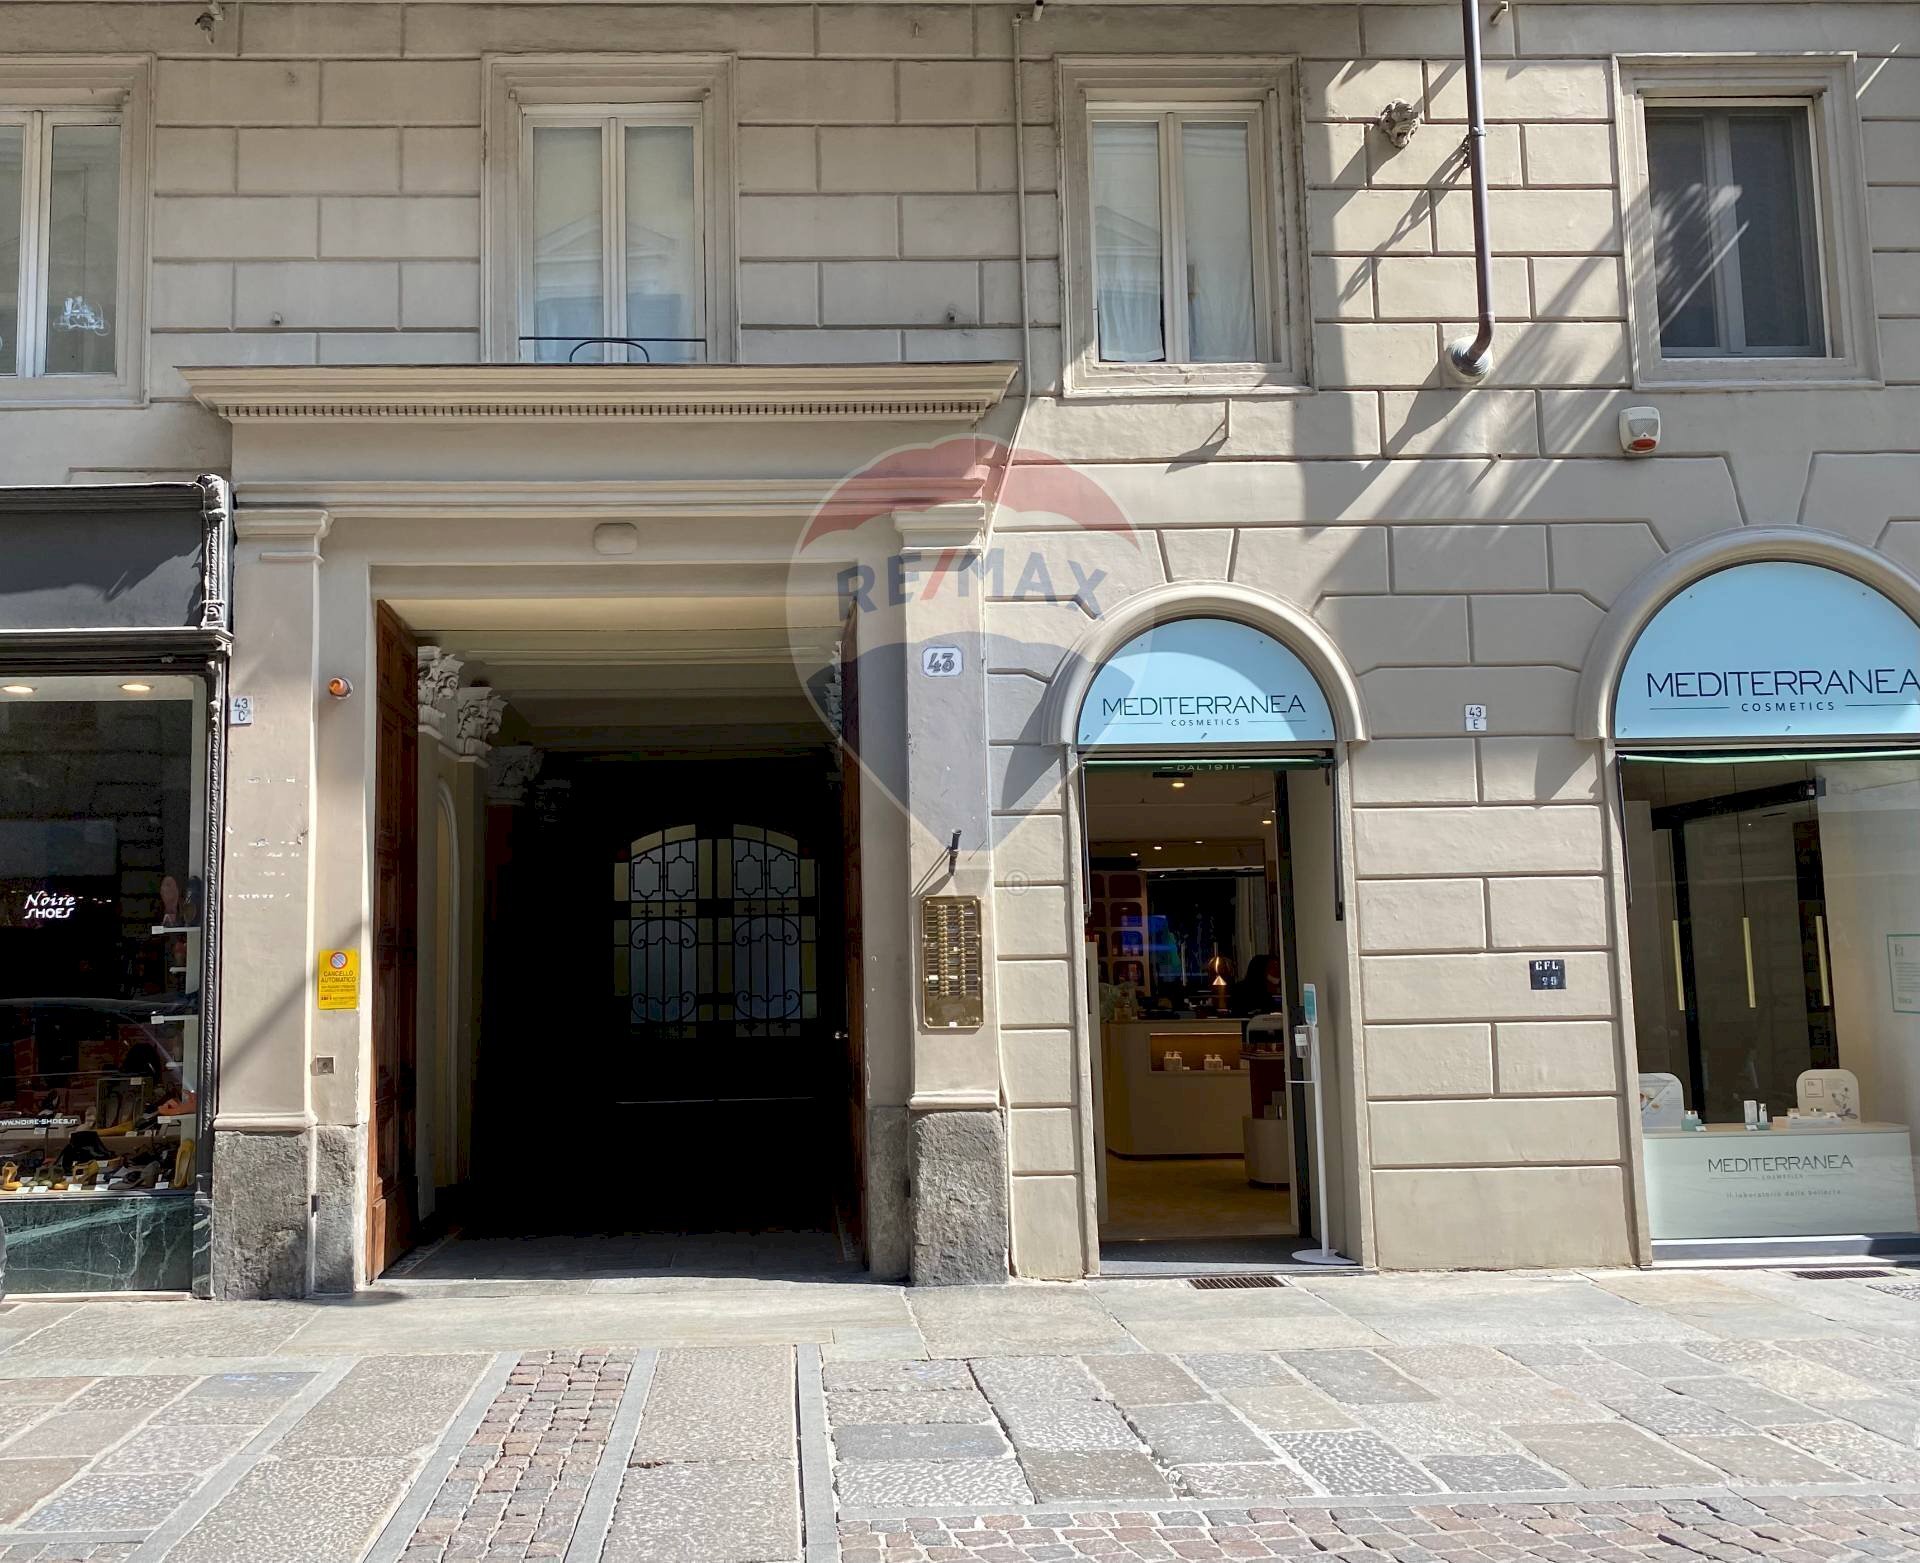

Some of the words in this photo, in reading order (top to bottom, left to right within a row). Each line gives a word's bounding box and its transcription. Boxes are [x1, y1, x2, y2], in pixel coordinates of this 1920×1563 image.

[927, 652, 955, 673] 43
[1647, 668, 1920, 698] MEDITERRANEA
[234, 697, 248, 709] 43
[1102, 694, 1306, 717] MEDITERRANEA
[1741, 701, 1835, 712] COSMETICS
[238, 710, 246, 722] C
[1469, 706, 1482, 718] 43
[1170, 718, 1241, 727] COSMETICS
[1473, 718, 1480, 730] E
[1208, 763, 1235, 771] 1911
[24, 890, 76, 909] Noire
[24, 907, 75, 919] SHOES
[1708, 1154, 1854, 1173] MEDITERRANEA
